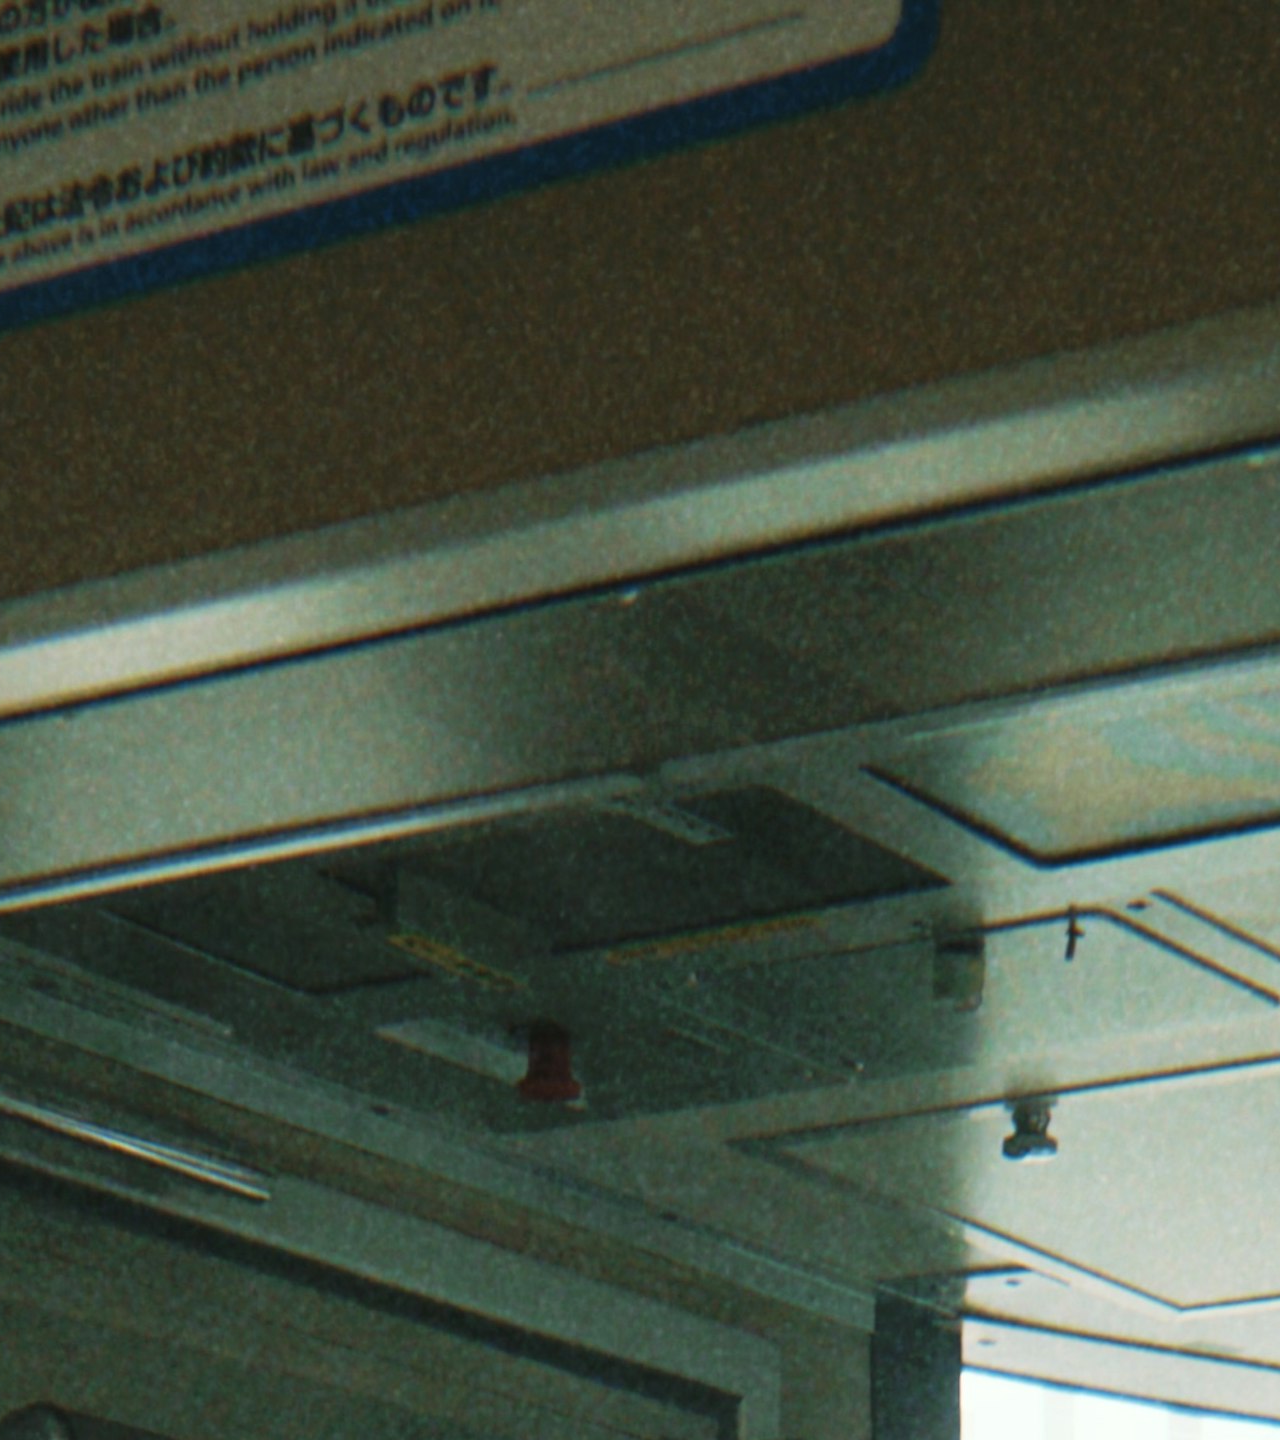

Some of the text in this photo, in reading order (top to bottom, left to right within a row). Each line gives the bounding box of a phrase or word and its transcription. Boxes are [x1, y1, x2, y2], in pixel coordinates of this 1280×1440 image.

[0, 84, 40, 118] ride
[50, 71, 82, 102] the
[90, 54, 142, 92] train
[149, 23, 239, 73] without
[247, 3, 335, 41] holding
[69, 93, 128, 131] other
[136, 76, 185, 112] than
[194, 61, 230, 94] the
[238, 44, 316, 84] person
[323, 6, 432, 53] indicated
[12, 229, 71, 262] above
[79, 222, 93, 245] is
[101, 217, 117, 237] in
[125, 178, 240, 228] accordance
[248, 162, 294, 196] with
[302, 150, 339, 182] law
[348, 137, 388, 171] and
